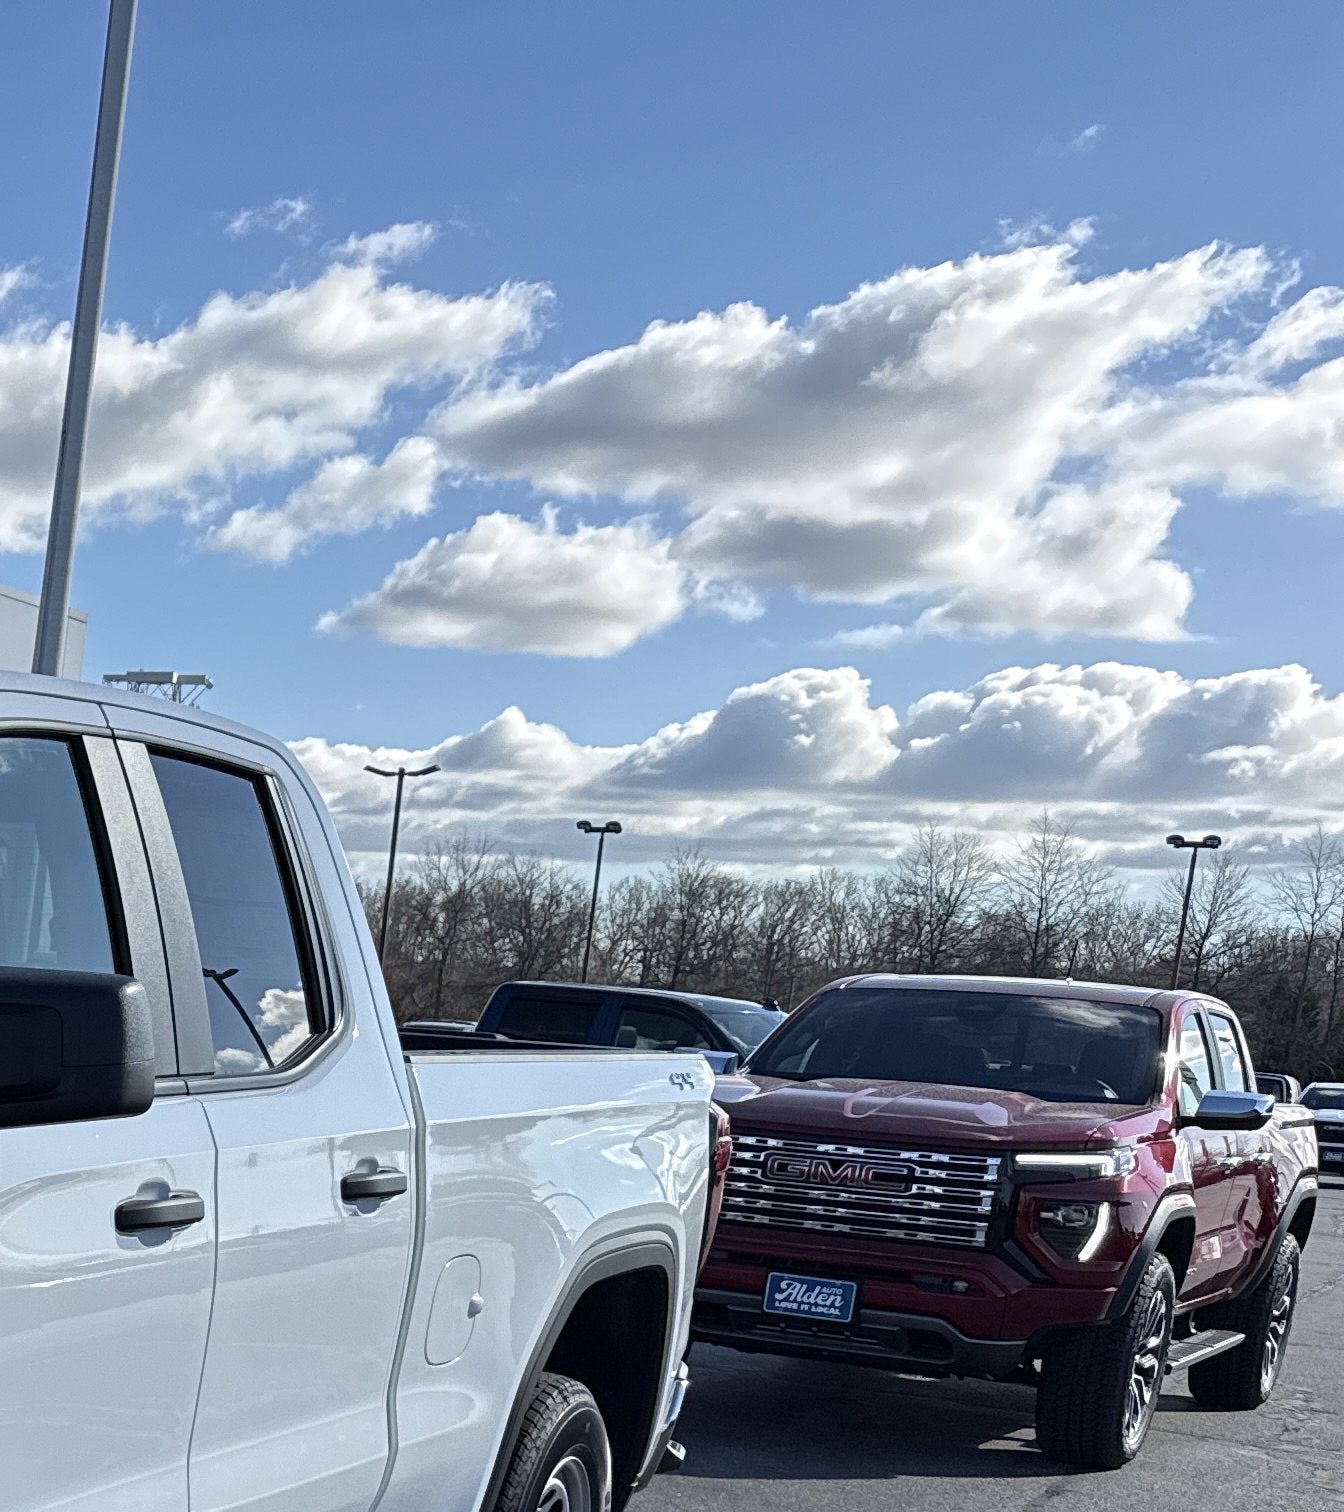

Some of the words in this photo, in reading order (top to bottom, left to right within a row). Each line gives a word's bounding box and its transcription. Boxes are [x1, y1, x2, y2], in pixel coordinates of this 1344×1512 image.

[767, 1154, 909, 1190] GMC
[774, 1280, 844, 1307] Alden
[821, 1286, 843, 1295] AUTO
[774, 1301, 799, 1310] LOVE
[800, 1303, 810, 1311] IT
[811, 1305, 841, 1316] LOCAL
